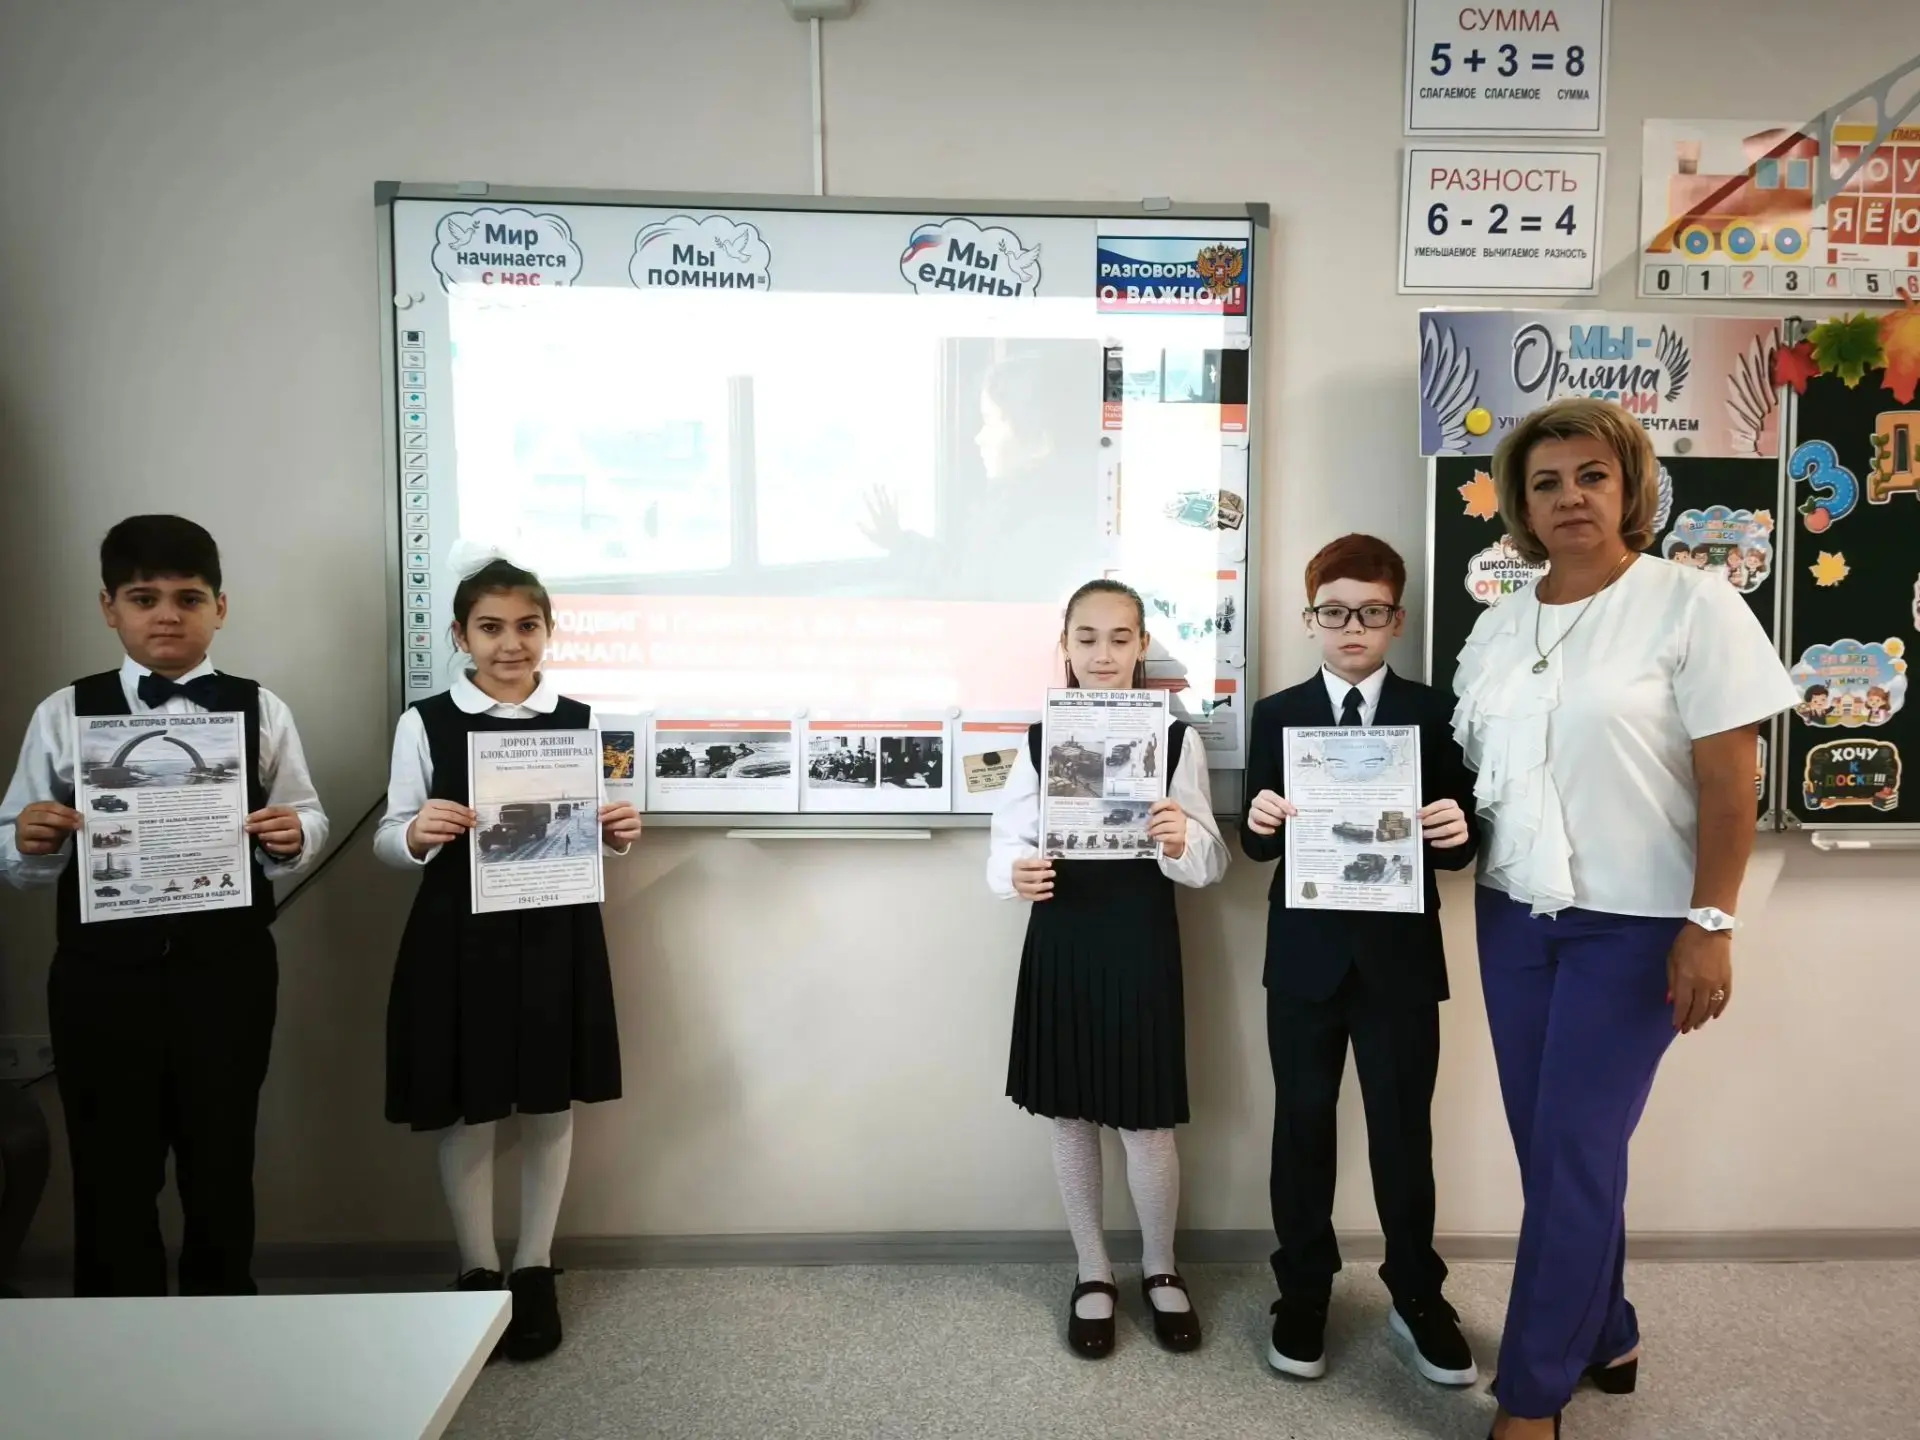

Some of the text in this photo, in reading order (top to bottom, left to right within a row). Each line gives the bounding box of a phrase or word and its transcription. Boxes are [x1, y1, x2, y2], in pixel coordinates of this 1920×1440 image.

[1458, 8, 1560, 32] СУММА
[1430, 42, 1452, 76] 5
[1497, 44, 1518, 77] 3
[1565, 45, 1585, 77] 8
[1419, 87, 1590, 100] СЛАГАЕМОЕ СЛАГАЕМОЕ СУММА
[1429, 168, 1578, 192] РАЗНОСТЬ
[1427, 202, 1449, 236] 6
[1488, 203, 1509, 235] 2
[1555, 205, 1577, 236] 4
[484, 223, 539, 249] Мир
[456, 252, 567, 268] начинается
[671, 243, 716, 267] Мы
[946, 238, 998, 272] Мы
[1414, 247, 1587, 259] УМЕНЬШАЕМОЕ ВЫЧИТАЕМОЕ РАЗНОСТЬ
[501, 272, 541, 287] нас
[648, 268, 755, 290] помним
[918, 262, 1022, 297] едины
[1657, 269, 1670, 291] 0
[1785, 270, 1798, 291] 3
[1866, 273, 1879, 293] 5
[1100, 285, 1241, 305] О ВАЖНОМ!
[1512, 323, 1661, 400] Орлята
[1639, 418, 1700, 431] ЕЧТАЕМ
[1494, 570, 1533, 579] СЕЗОН:
[1475, 580, 1528, 595] ОТКР
[1065, 691, 1085, 699] ПУТЬ
[1110, 692, 1128, 700] ВОДУ
[169, 717, 207, 726] СПАСАЛА
[1297, 730, 1349, 738] ЕДИНСТВЕННЫЙ
[1350, 729, 1366, 737] ПУТЬ
[1367, 729, 1385, 737] ЧЕРЕЗ
[500, 736, 575, 748] ДОРОГА ЖИЗНИ
[480, 747, 594, 760] БЛОКАДНОГО ЛЕНИНГРАДА
[1831, 747, 1879, 762] ХОЧУ
